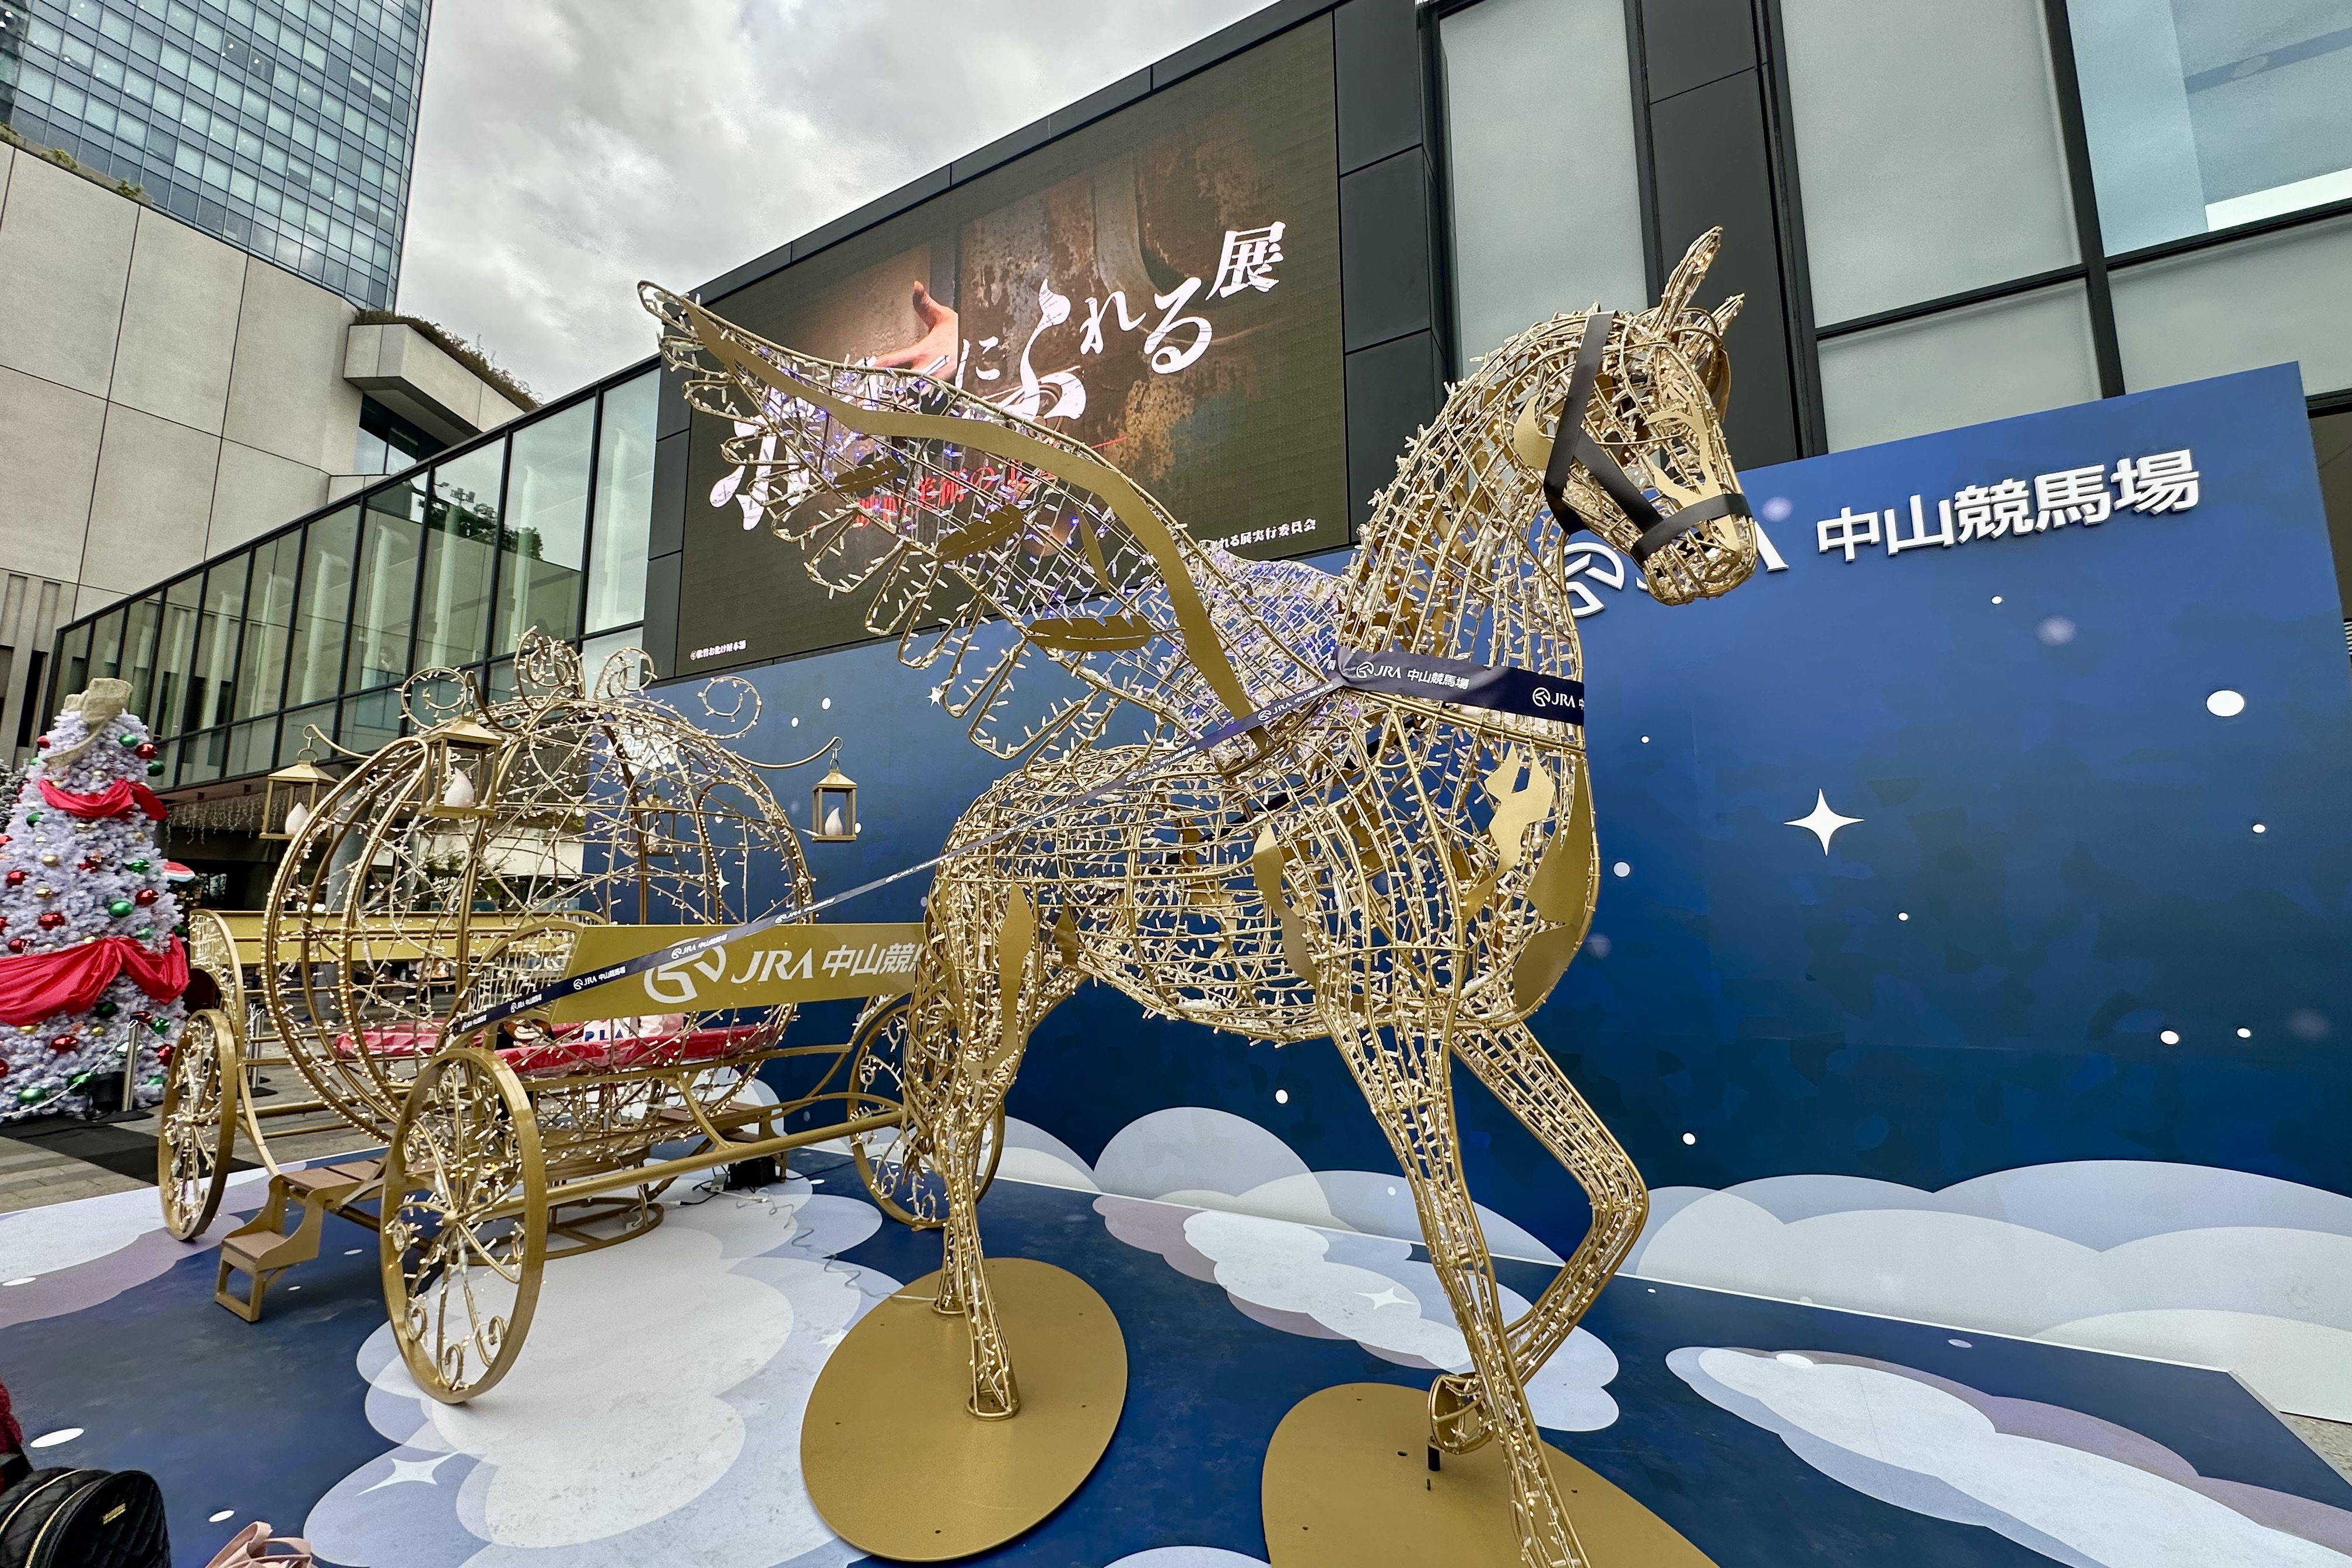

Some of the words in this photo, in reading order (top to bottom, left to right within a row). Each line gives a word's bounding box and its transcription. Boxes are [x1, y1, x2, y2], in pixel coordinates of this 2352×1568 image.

[1817, 449, 2200, 562] 中山競馬場
[1374, 665, 1401, 679] JRA
[1406, 668, 1470, 690] 中山競馬場
[1272, 702, 1293, 715] JRA
[1551, 692, 1576, 708] JRA
[730, 947, 814, 984] JRA
[584, 975, 597, 986] JRA
